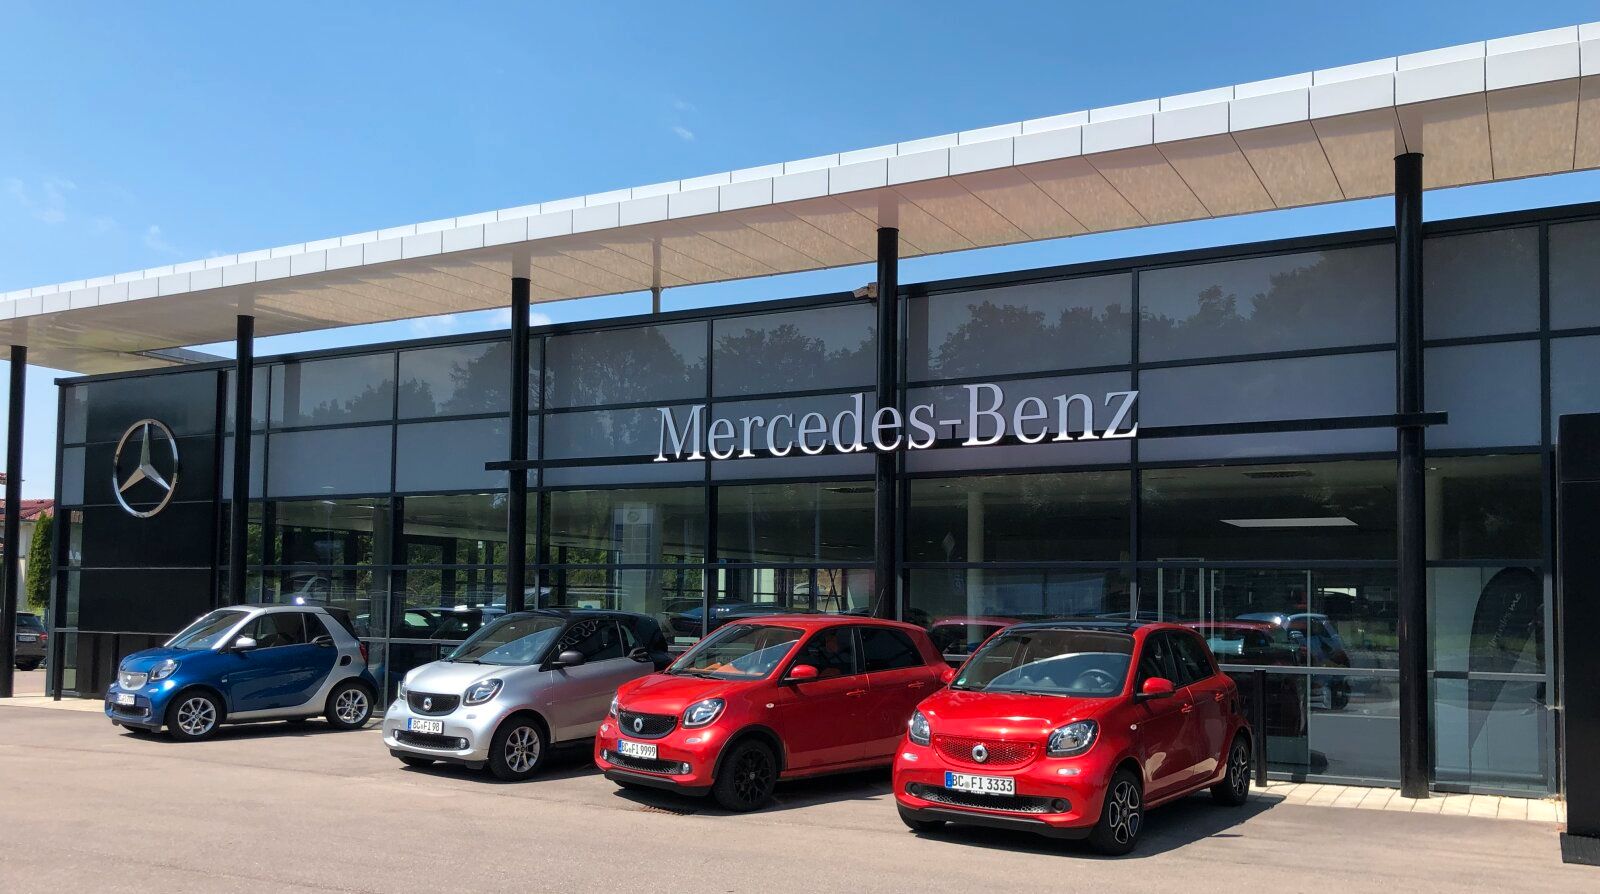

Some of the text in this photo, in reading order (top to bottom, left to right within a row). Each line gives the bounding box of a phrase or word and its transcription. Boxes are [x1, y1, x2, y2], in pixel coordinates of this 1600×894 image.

[653, 382, 1140, 463] Mercedes-Benz
[641, 745, 656, 757] 9999
[953, 774, 964, 787] BC
[971, 776, 983, 790] FI
[986, 777, 1013, 792] 3333
